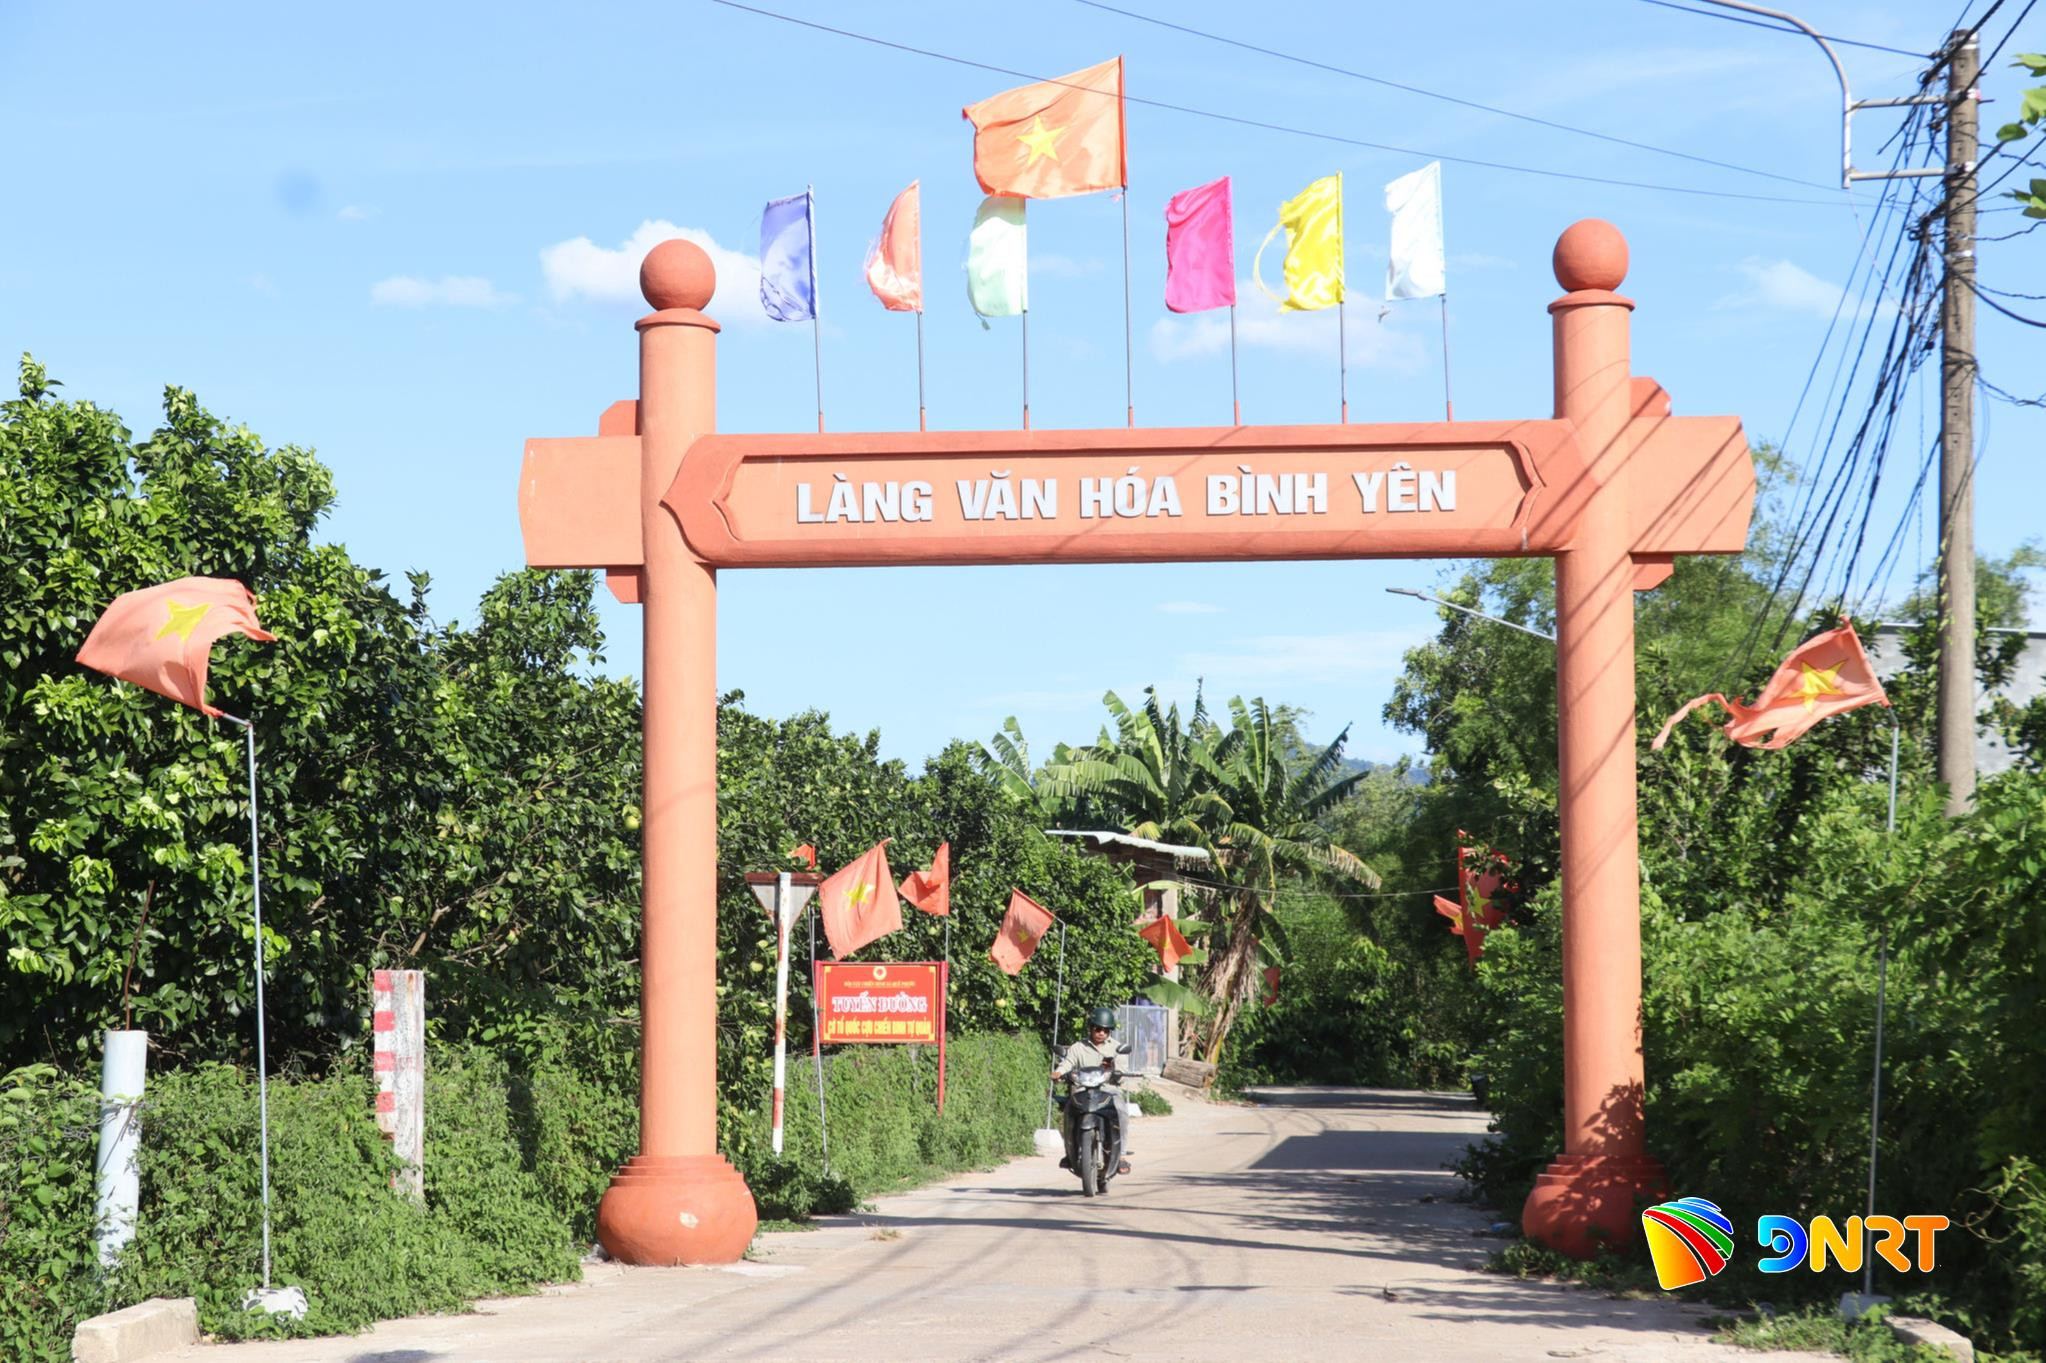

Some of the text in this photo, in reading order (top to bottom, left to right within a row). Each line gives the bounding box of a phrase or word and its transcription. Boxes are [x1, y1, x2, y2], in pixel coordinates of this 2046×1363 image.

[797, 461, 1456, 523] LÀNG VĂN HÓA BÌNH YÊN
[832, 991, 928, 1013] TUYẾN ĐƯỜNG
